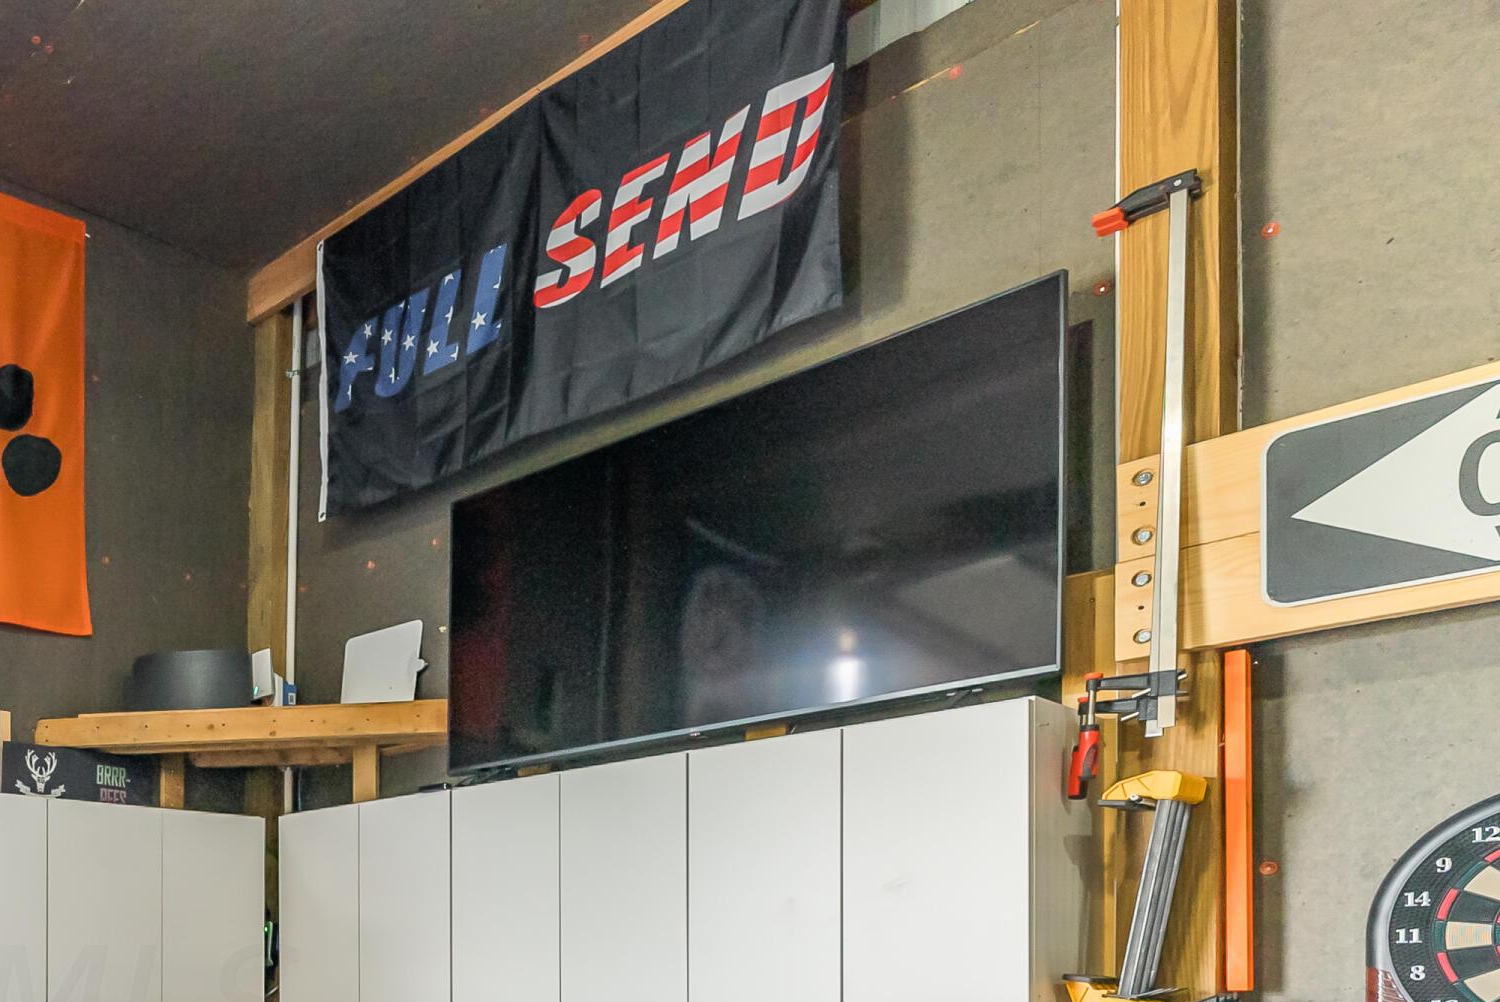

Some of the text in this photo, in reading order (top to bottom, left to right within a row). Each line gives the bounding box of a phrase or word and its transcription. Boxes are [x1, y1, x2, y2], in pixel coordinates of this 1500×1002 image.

[333, 62, 835, 414] FULL SEND
[96, 764, 131, 788] BRRR-
[1471, 826, 1500, 843] 12
[1436, 857, 1452, 874] 9
[1404, 891, 1431, 907] 14
[1395, 928, 1422, 944] 11
[1410, 965, 1426, 981] 8
